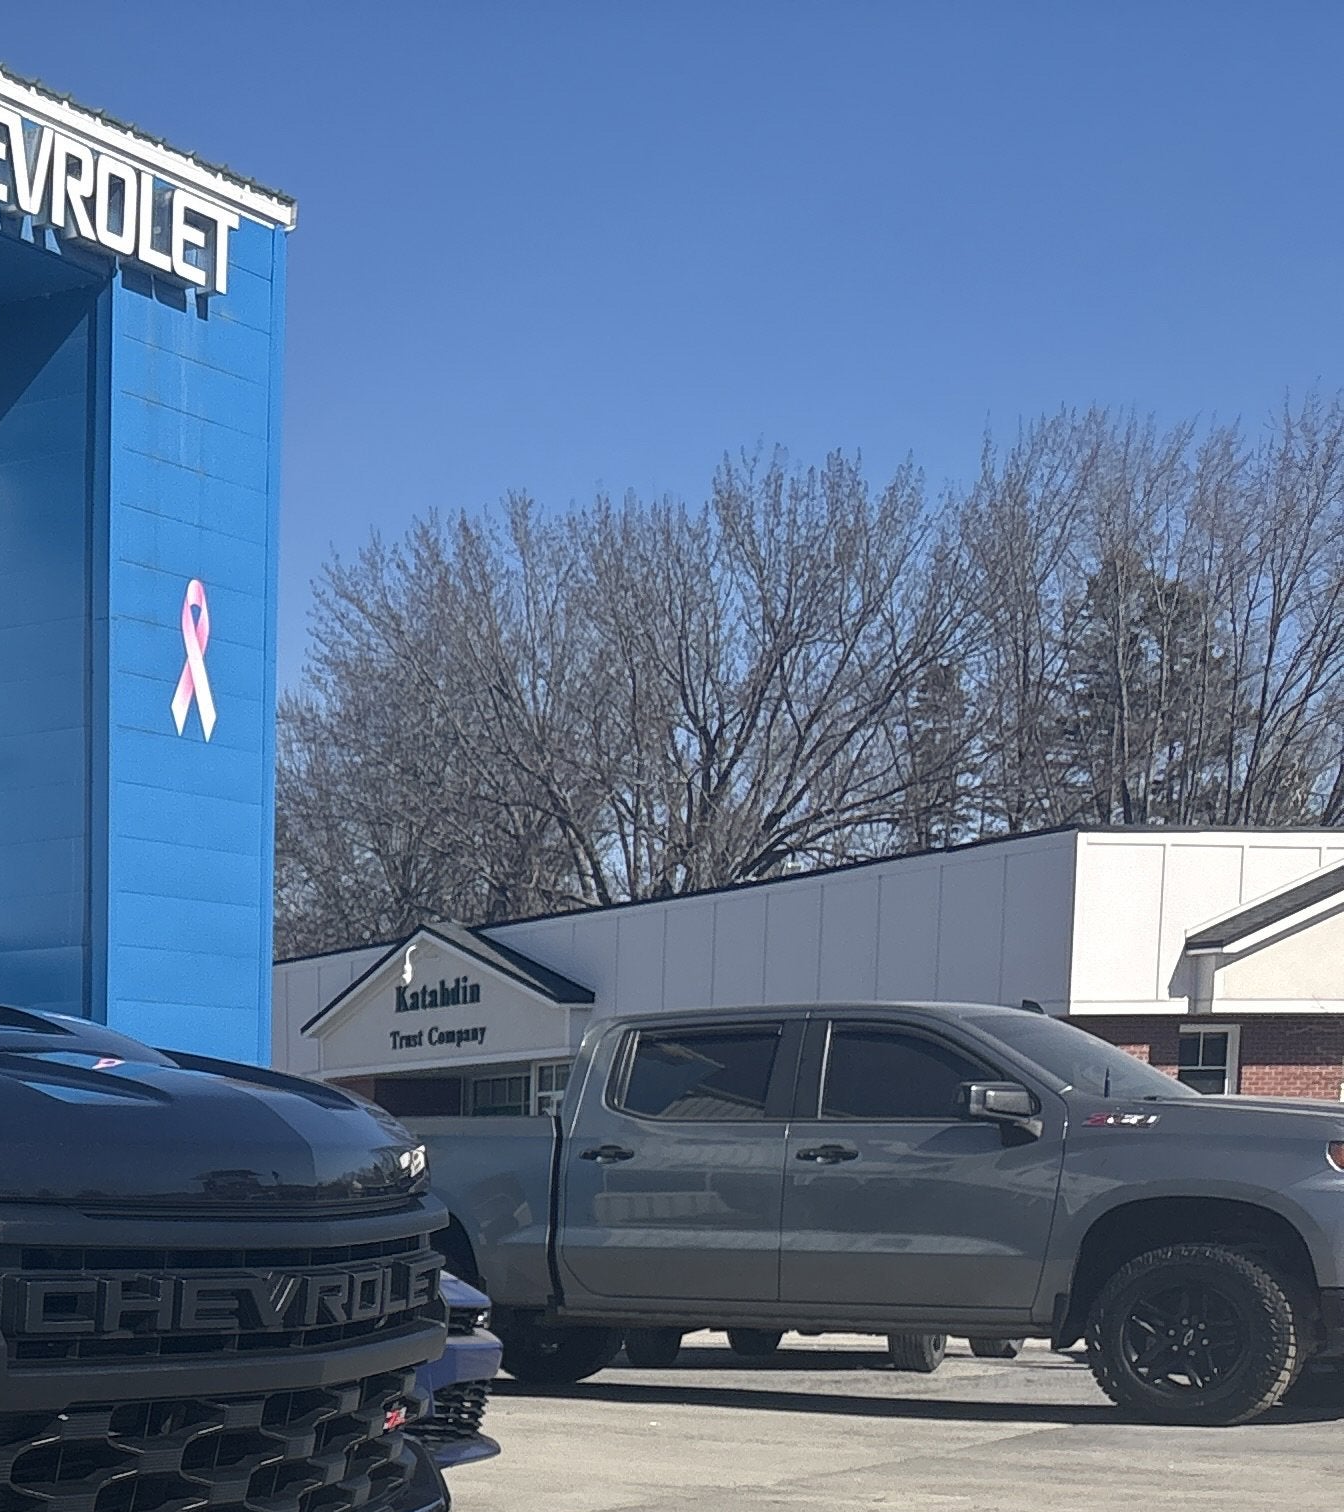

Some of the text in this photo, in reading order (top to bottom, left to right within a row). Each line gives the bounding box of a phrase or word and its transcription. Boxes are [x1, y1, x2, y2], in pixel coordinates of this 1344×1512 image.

[395, 976, 481, 1013] Katahdin
[390, 1026, 487, 1050] Trust Company
